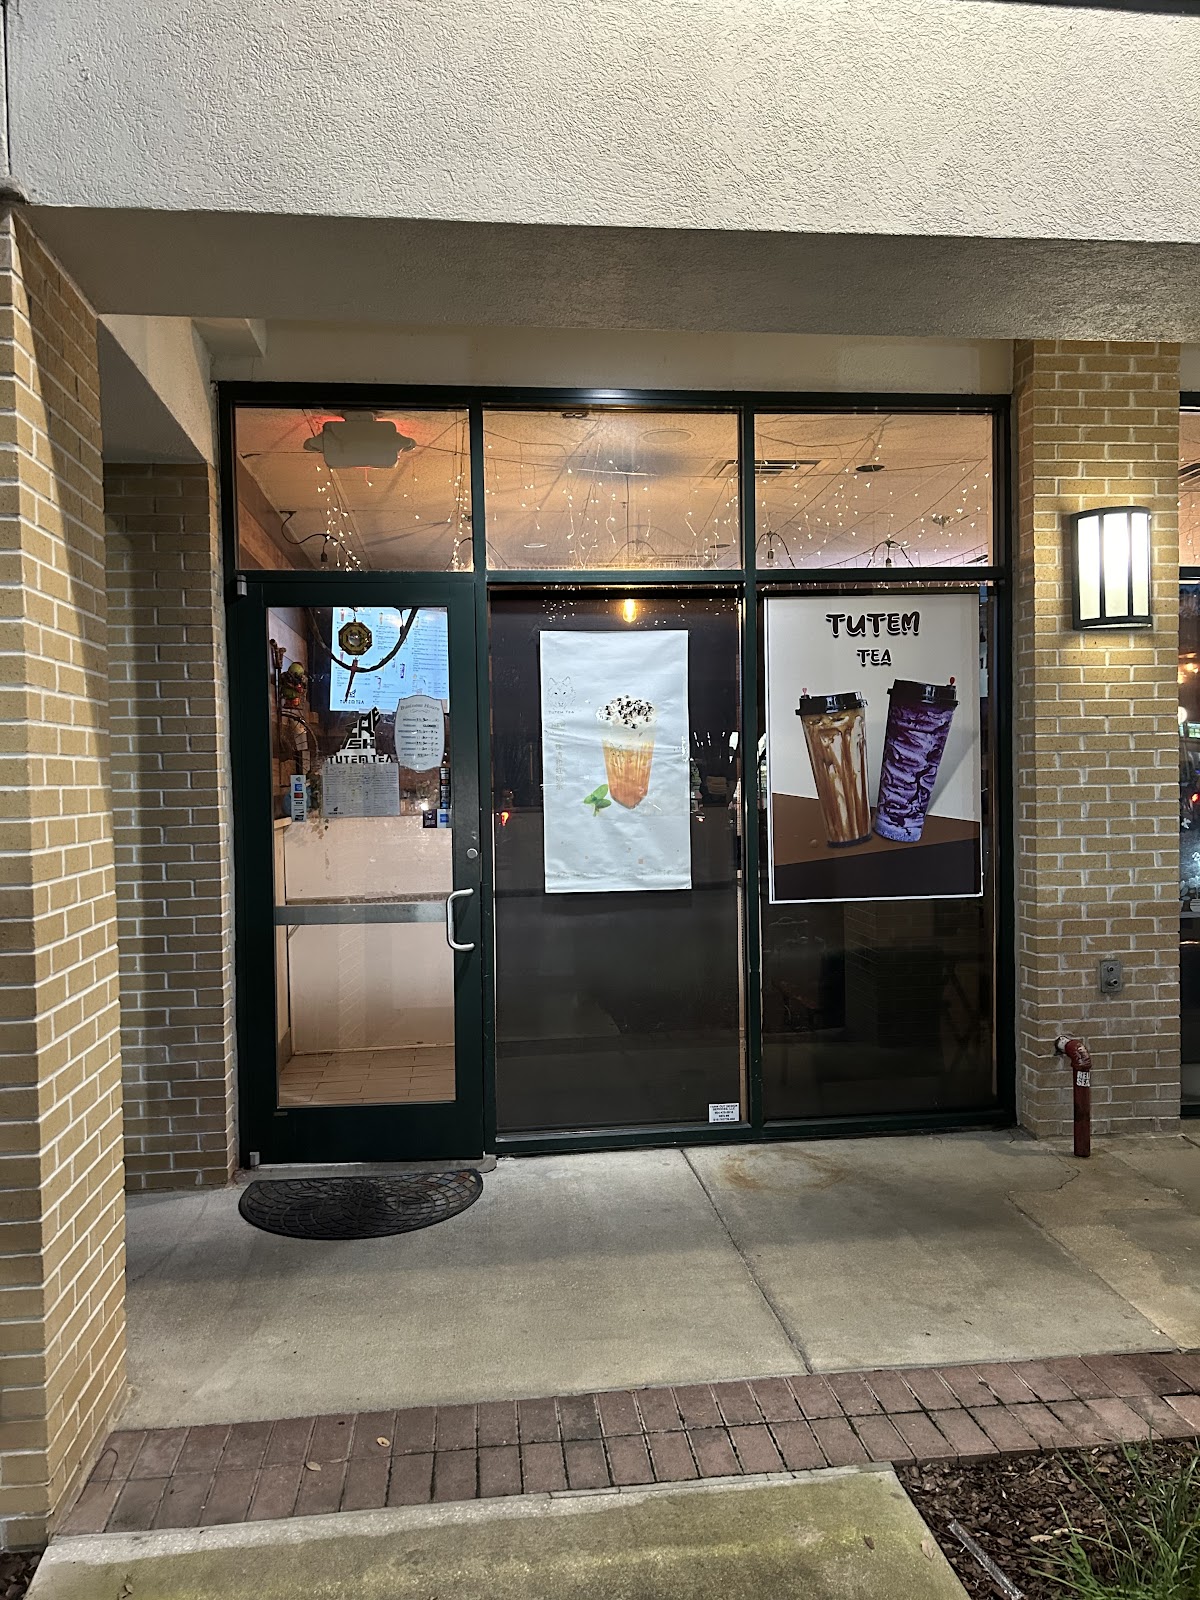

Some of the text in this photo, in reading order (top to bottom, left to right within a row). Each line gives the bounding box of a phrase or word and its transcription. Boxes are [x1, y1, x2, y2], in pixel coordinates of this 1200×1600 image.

[825, 611, 920, 638] TUTEM
[856, 649, 892, 667] TEA
[328, 755, 369, 764] TUTEM
[371, 754, 393, 763] TEA
